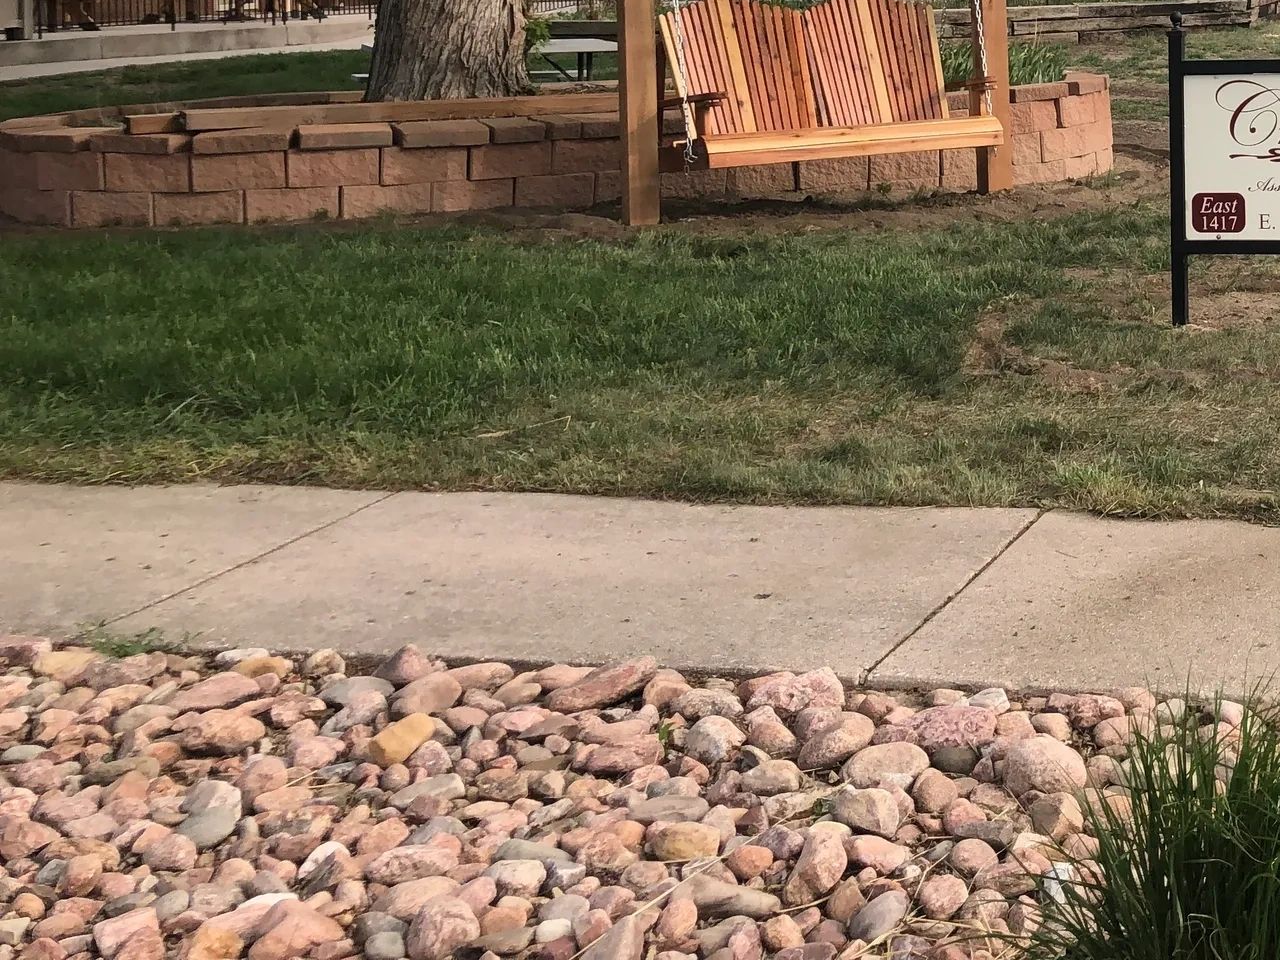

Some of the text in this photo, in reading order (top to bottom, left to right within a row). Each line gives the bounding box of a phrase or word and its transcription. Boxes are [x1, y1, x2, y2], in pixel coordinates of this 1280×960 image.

[1200, 197, 1238, 214] East
[1201, 215, 1238, 231] 1417
[1258, 214, 1276, 230] E.
